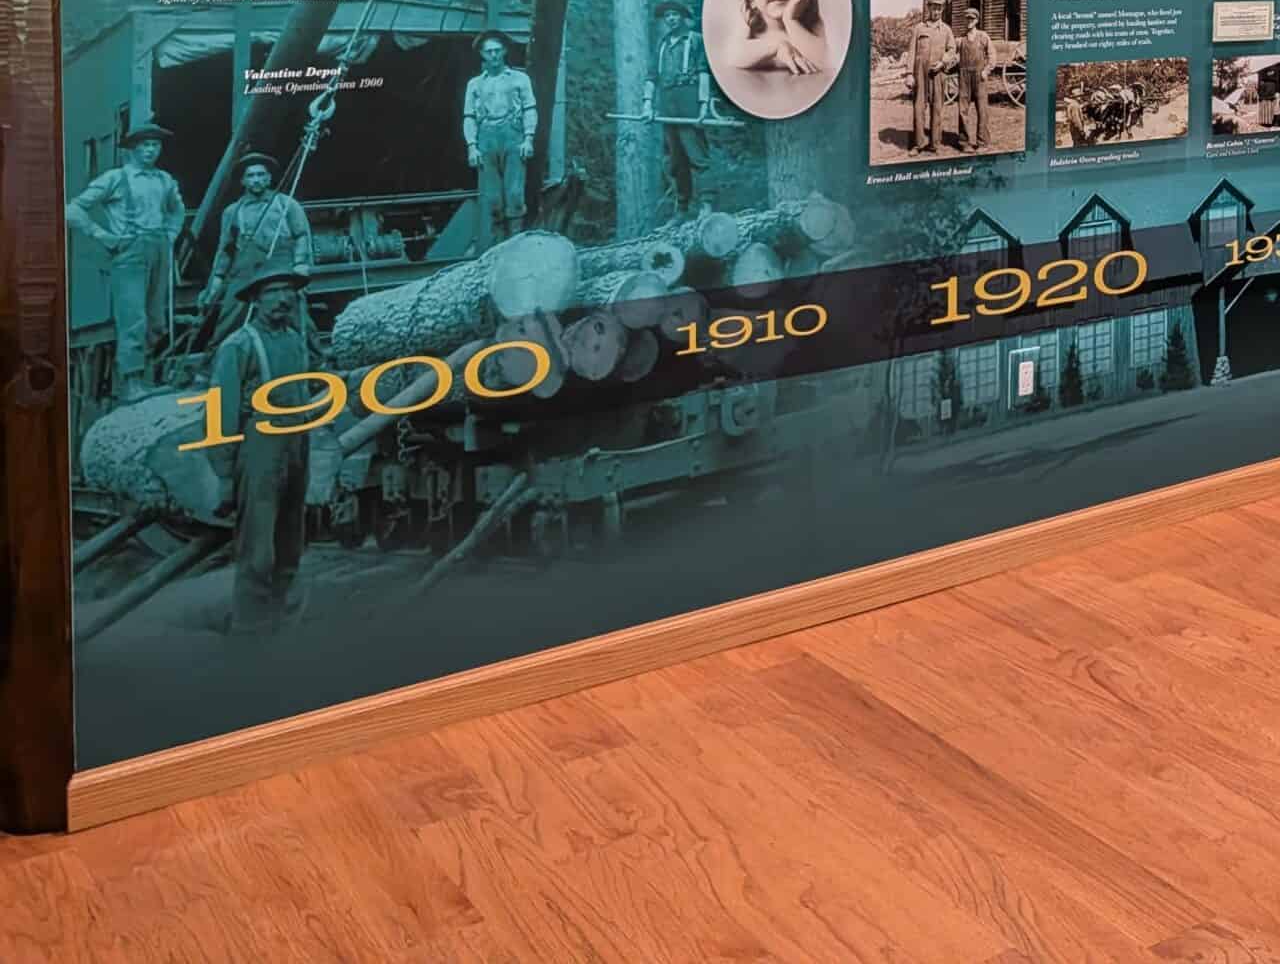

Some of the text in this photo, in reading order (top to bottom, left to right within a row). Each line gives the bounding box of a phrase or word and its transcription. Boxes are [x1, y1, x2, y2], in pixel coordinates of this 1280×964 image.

[245, 68, 302, 79] Valentine
[931, 250, 1148, 325] 1920
[675, 304, 828, 355] 1910
[177, 341, 551, 450] 1900
